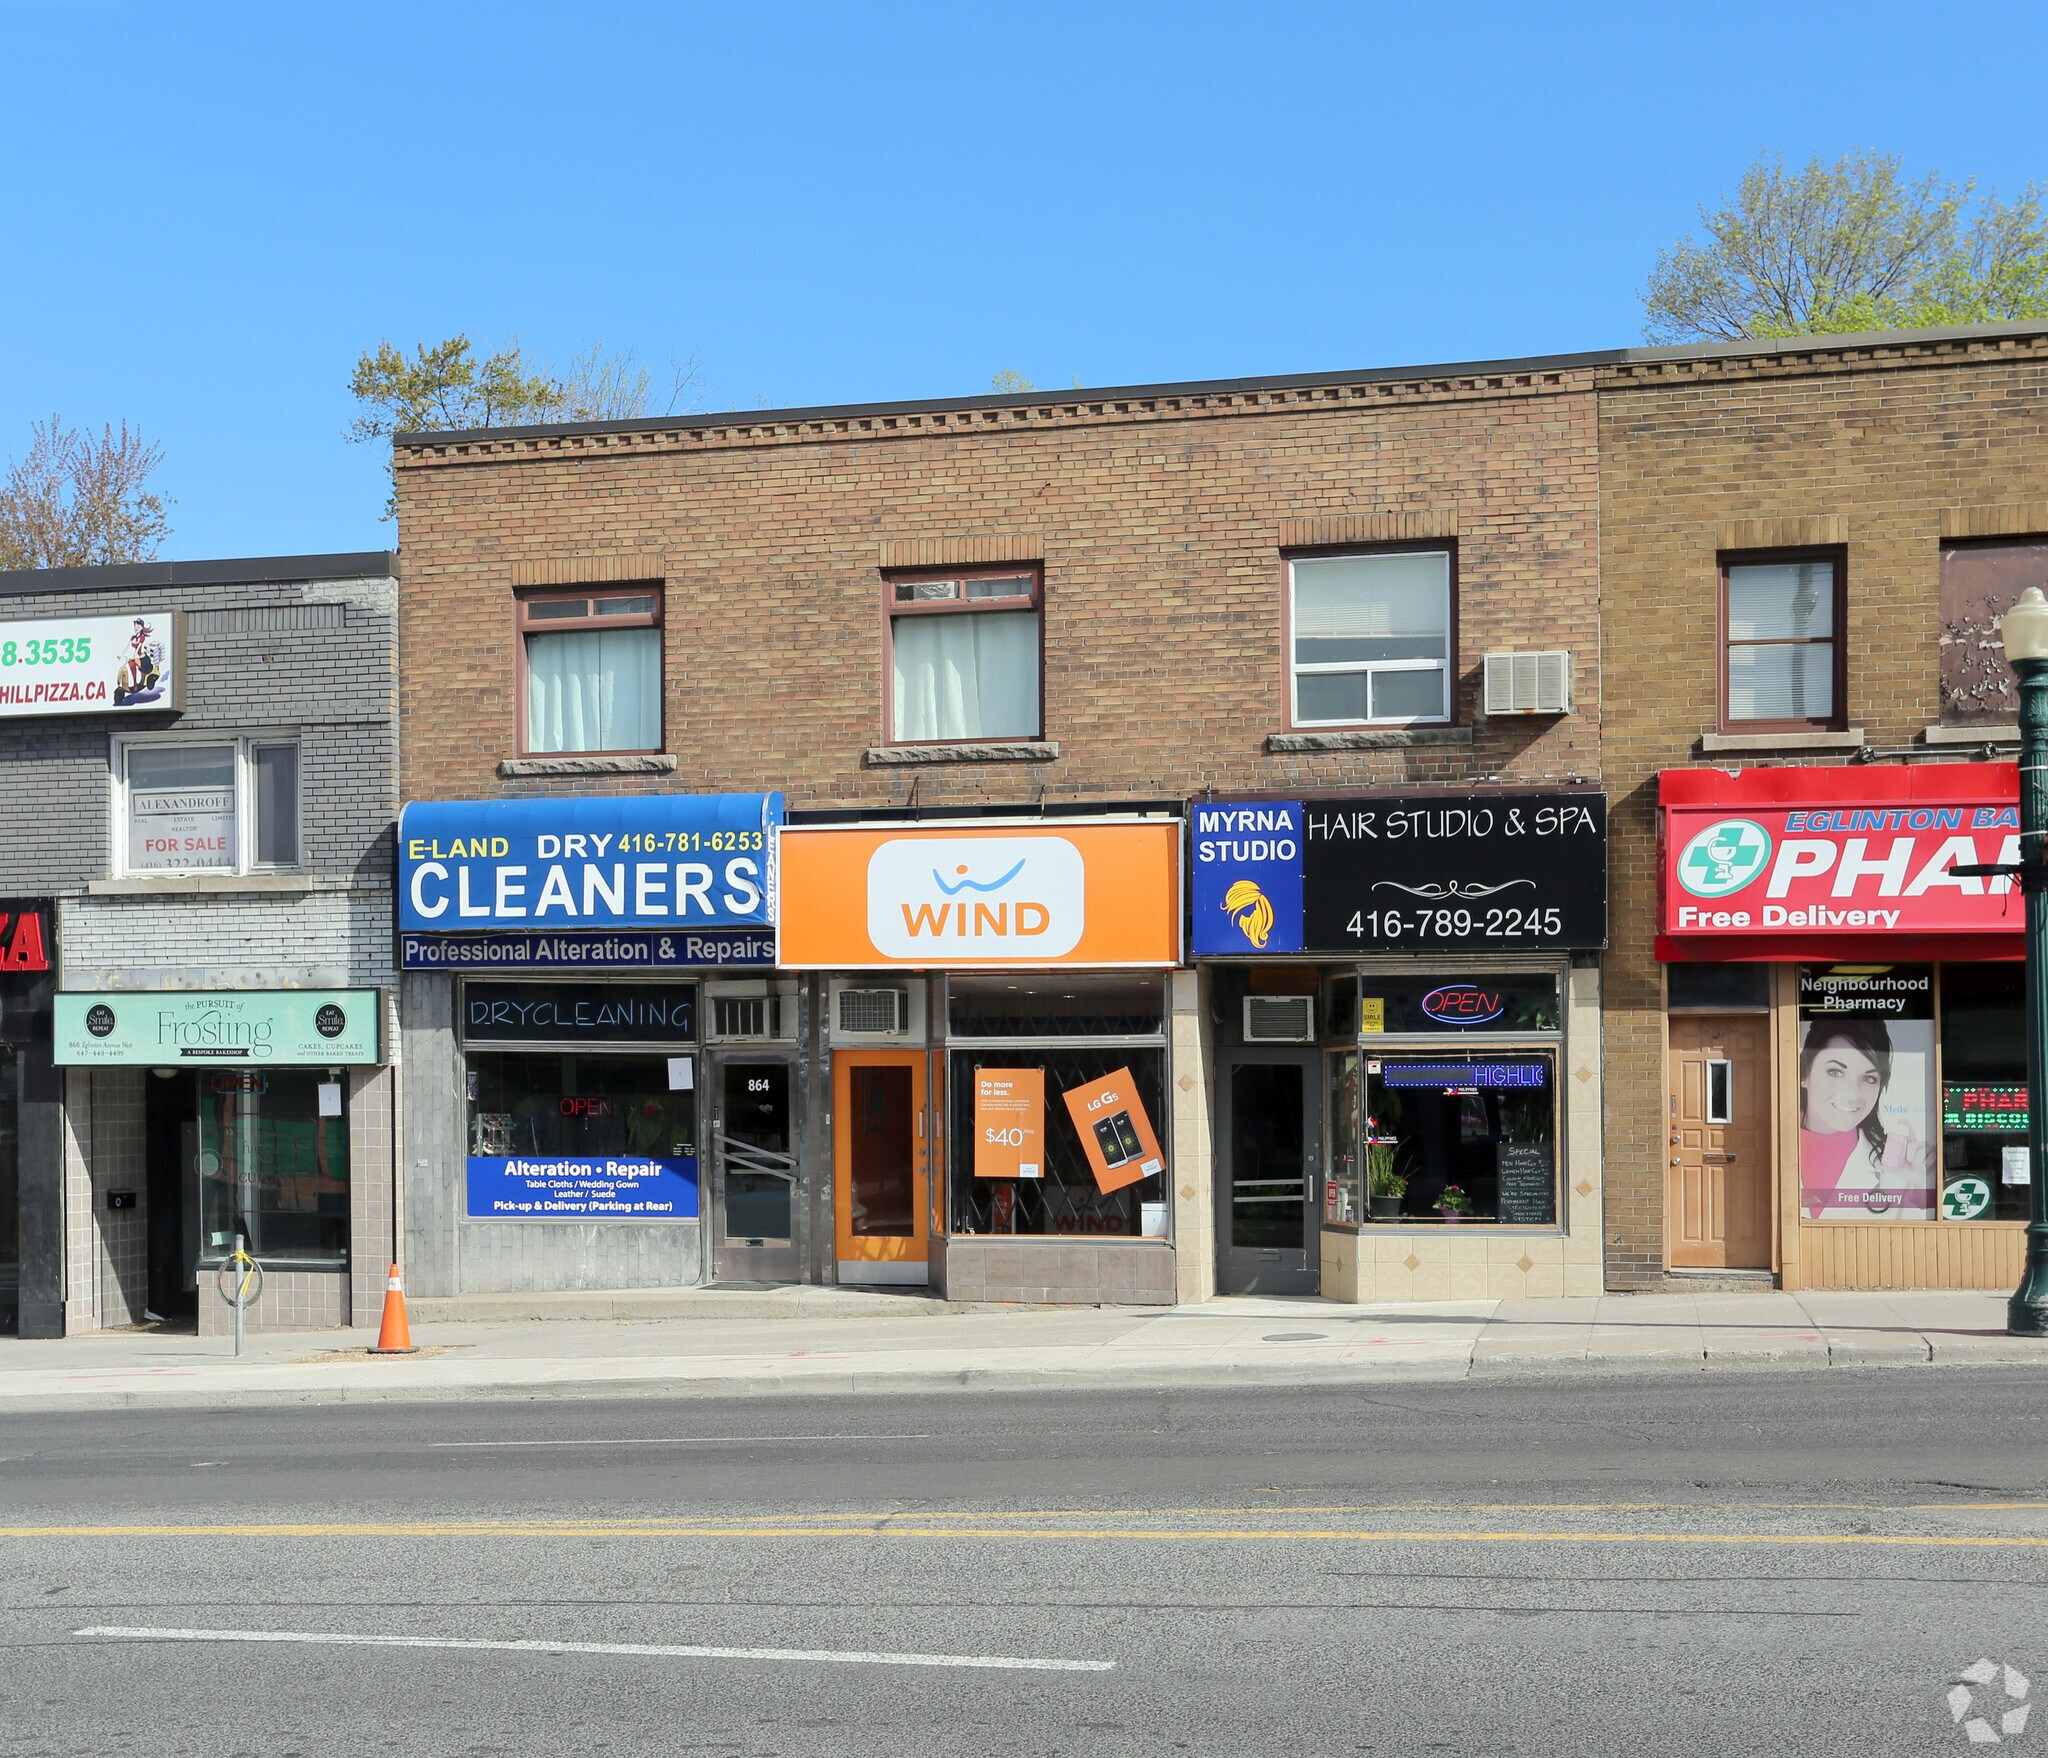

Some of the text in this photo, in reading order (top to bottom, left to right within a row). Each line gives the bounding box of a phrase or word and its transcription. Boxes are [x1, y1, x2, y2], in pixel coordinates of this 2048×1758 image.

[1, 637, 92, 667] 8.3535
[139, 797, 230, 810] ALEXANDROFF
[1199, 810, 1294, 833] MYRNA
[1308, 807, 1597, 840] HAIR STUDIO & SPA
[1784, 808, 1963, 832] EGLINTON
[145, 837, 226, 852] FOR SALE
[409, 831, 763, 860] E-LAND DRY 416-781-6253
[1199, 839, 1297, 862] STUDIO
[410, 857, 761, 919] CLEANERS
[900, 902, 1051, 937] WIND
[1346, 908, 1562, 938] 416-789-2245
[1678, 905, 1901, 929] Free Delivery
[405, 937, 775, 963] Professional Alteration & Repairs
[1801, 977, 1929, 994] Neighbourhood
[196, 1000, 236, 1009] PURSUIT
[1423, 991, 1499, 1012] OPEN
[1823, 996, 1906, 1012] Pharmacy
[469, 998, 692, 1032] DRYCLEANING
[157, 1010, 274, 1057] Frosting
[748, 1079, 769, 1091] 864
[560, 1097, 612, 1116] OPEN
[1087, 1100, 1102, 1111] LG
[504, 1160, 662, 1180] Alteration Repair
[525, 1180, 547, 1188] Table
[547, 1180, 573, 1188] Cloths
[579, 1180, 615, 1190] Wedding
[615, 1180, 640, 1188] Gown
[554, 1190, 584, 1198] Leather
[591, 1190, 616, 1198] Suede
[493, 1201, 673, 1213] Pick-up & Delivery (Parking at Rear)
[1838, 1192, 1903, 1204] Free Delivery
